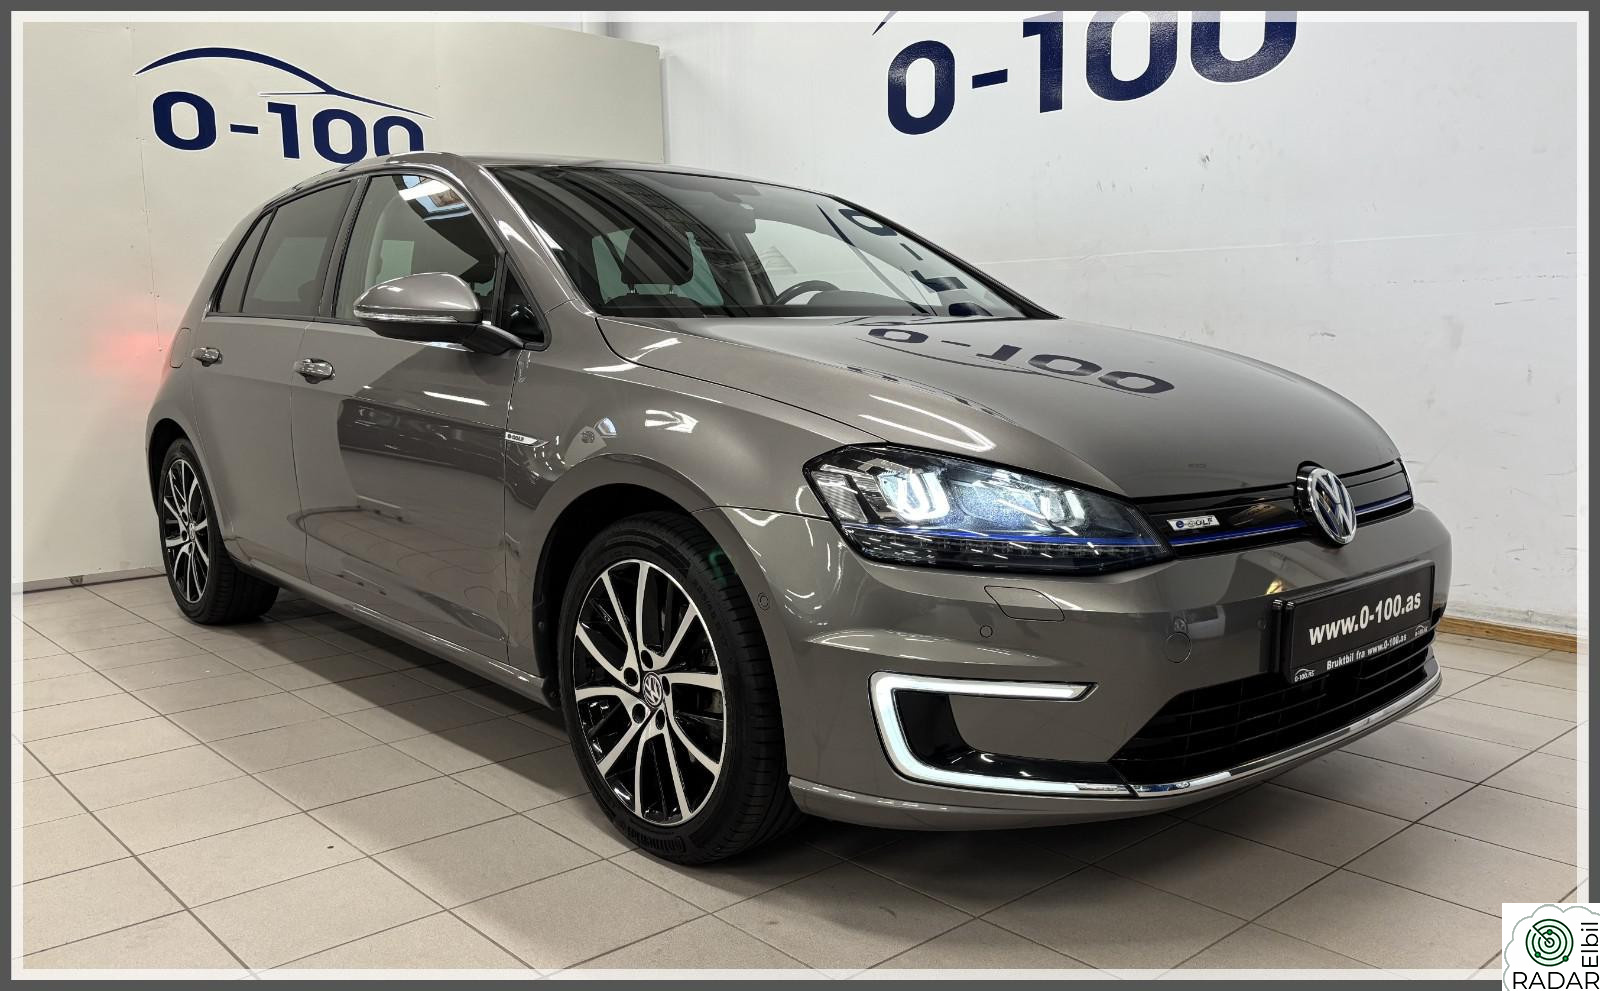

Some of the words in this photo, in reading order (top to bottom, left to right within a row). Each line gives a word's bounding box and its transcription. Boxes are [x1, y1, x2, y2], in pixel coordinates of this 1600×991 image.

[888, 11, 1298, 135] 0-100
[152, 90, 425, 165] 0-100
[1308, 591, 1422, 646] www.0-100.as
[1326, 653, 1355, 671] Bruktbil
[1356, 650, 1366, 659] fra
[1367, 633, 1407, 656] www.0-100.as
